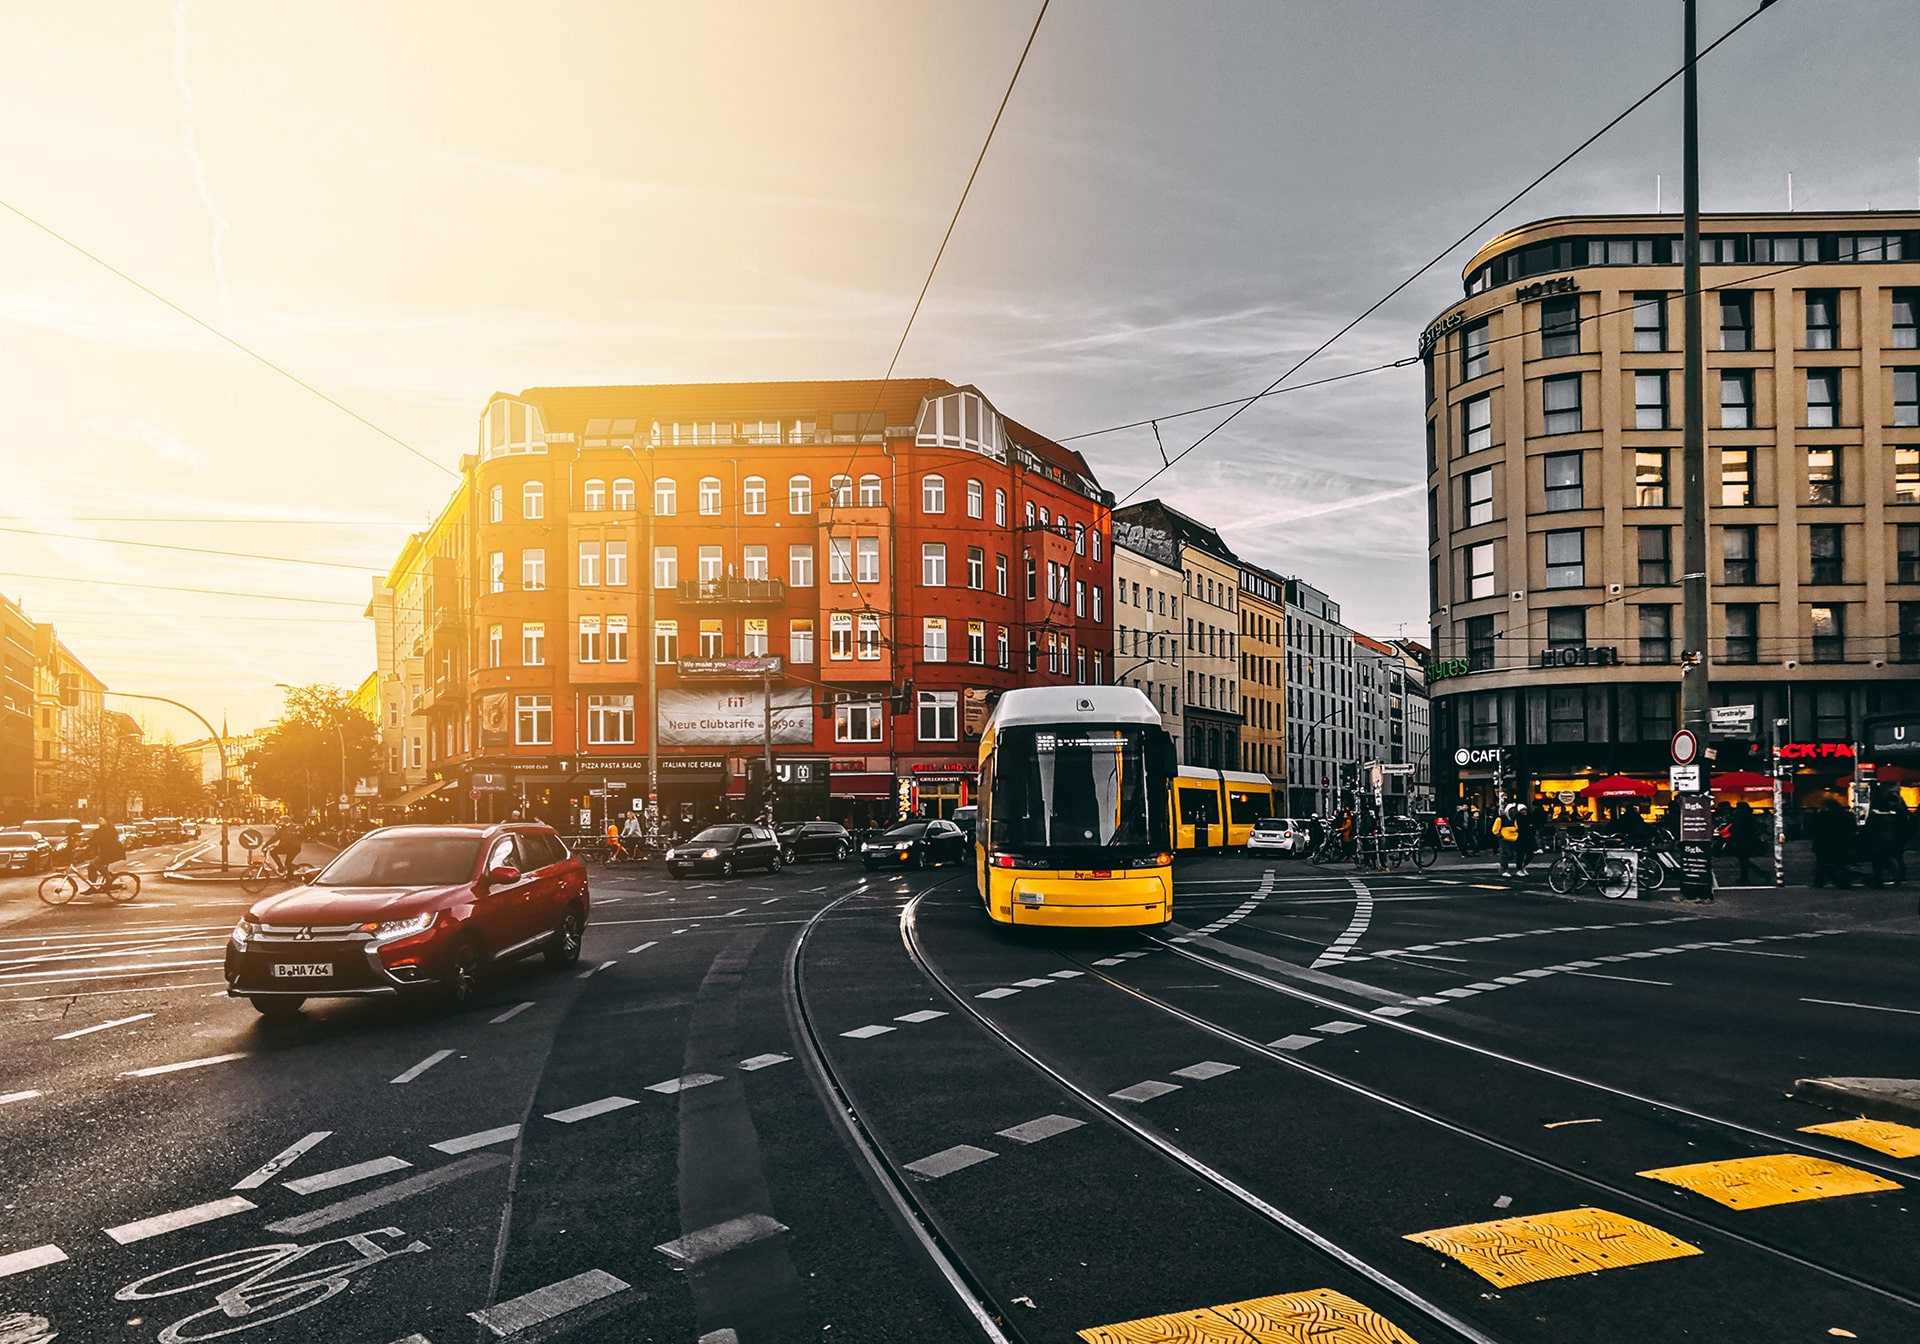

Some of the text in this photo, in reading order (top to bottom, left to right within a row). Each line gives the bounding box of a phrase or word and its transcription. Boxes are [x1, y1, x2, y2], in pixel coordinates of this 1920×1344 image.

[1516, 276, 1580, 302] HOTEL
[969, 623, 981, 631] YOU
[1541, 646, 1624, 667] HOTEL
[695, 660, 713, 668] make
[714, 662, 727, 670] you
[669, 720, 697, 729] Neue
[700, 718, 755, 729] Clubtarife
[1894, 726, 1905, 740] U
[485, 774, 493, 783] U
[279, 965, 328, 976] B HA 764
